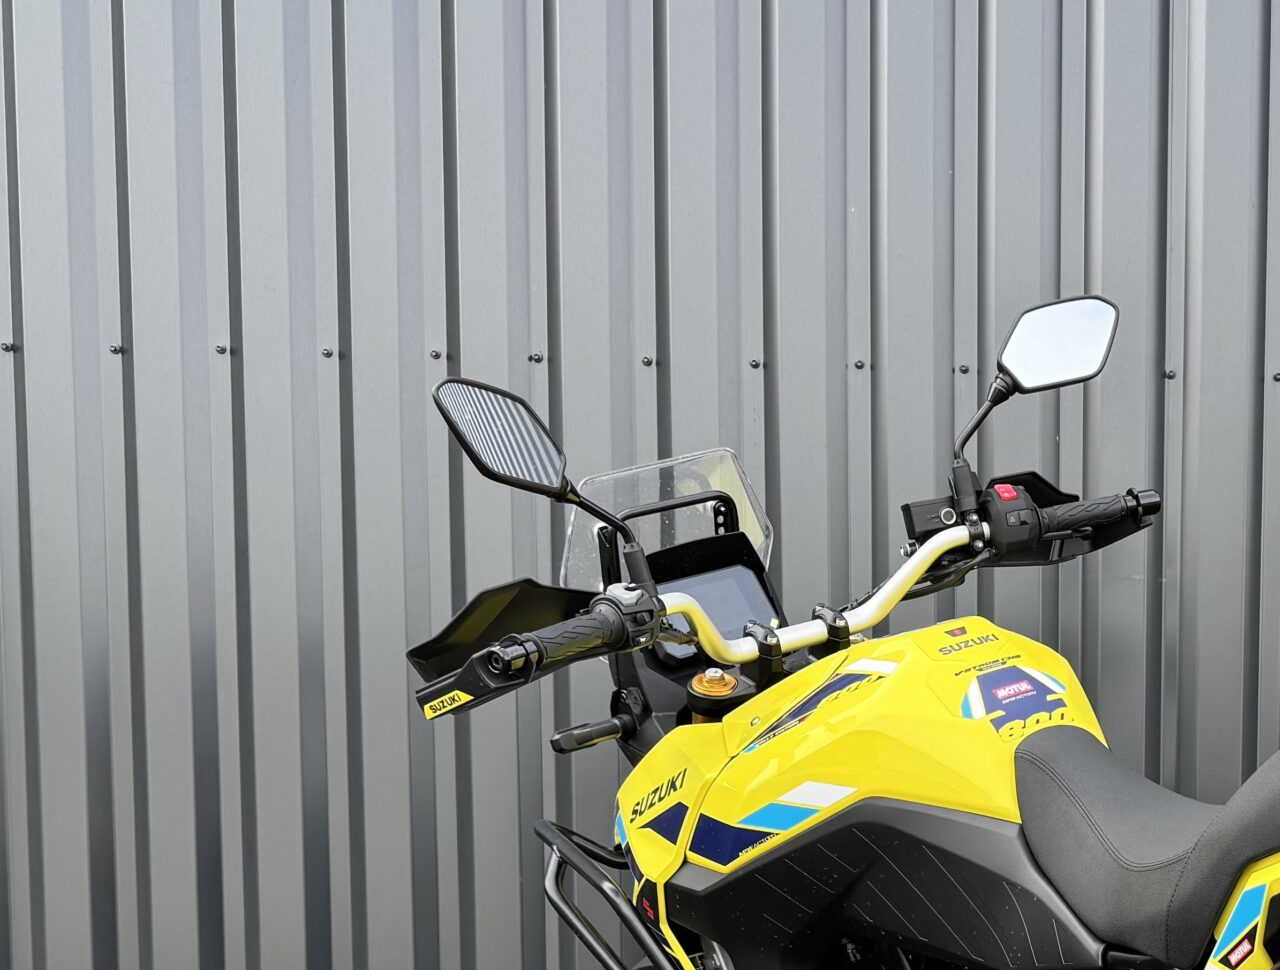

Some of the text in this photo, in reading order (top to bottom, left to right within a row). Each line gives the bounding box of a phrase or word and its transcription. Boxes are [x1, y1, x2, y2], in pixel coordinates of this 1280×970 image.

[938, 633, 1000, 656] SUZUKI
[995, 681, 1034, 699] MOTUL
[429, 693, 463, 714] SUZUKI
[630, 768, 688, 824] SUZUKI
[1227, 938, 1253, 967] MOTUL
